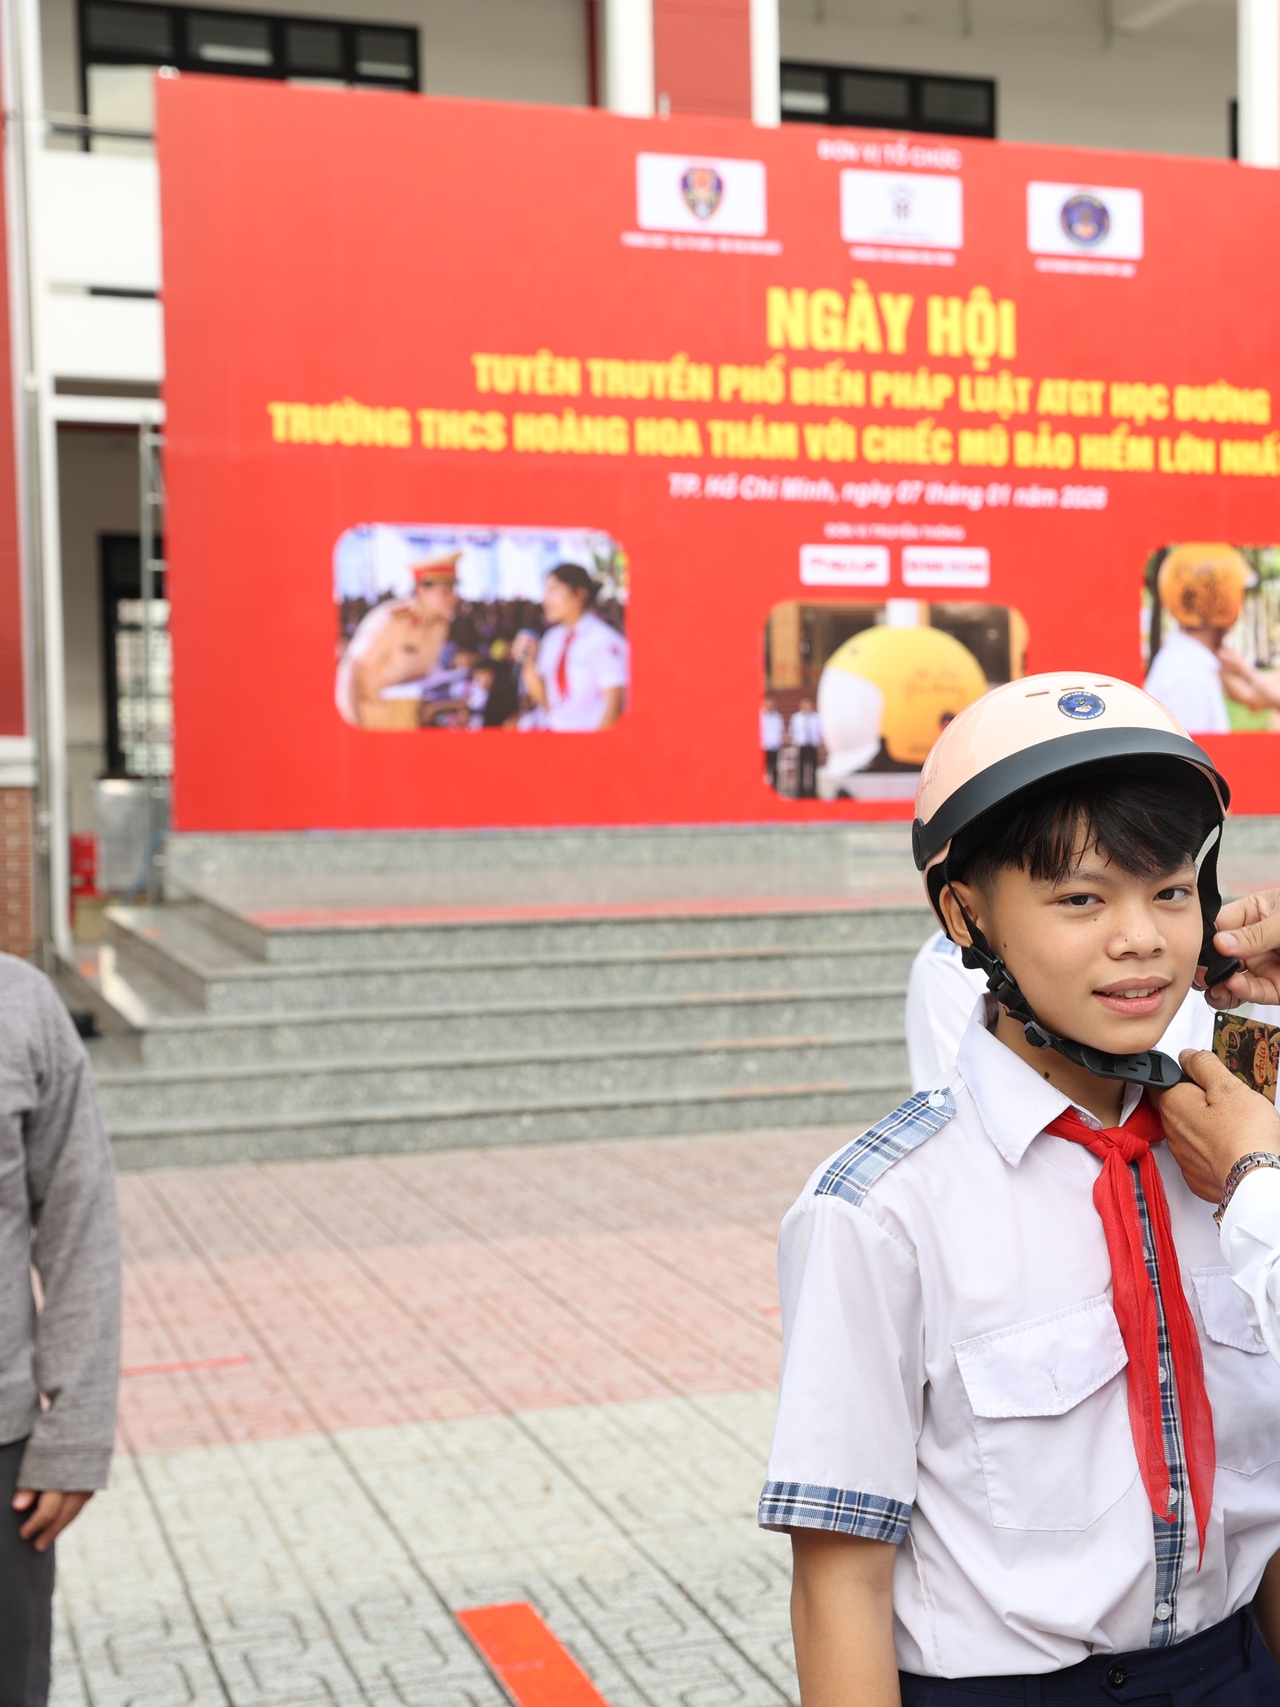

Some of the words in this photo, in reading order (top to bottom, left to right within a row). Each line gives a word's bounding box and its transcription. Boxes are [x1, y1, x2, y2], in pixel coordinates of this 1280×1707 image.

[766, 280, 914, 355] NGÀY
[927, 286, 1017, 371] HỘI
[586, 353, 713, 402] TRUYỀN
[718, 356, 786, 404] PHỔ
[790, 362, 866, 407] BIẾN
[870, 366, 954, 411] PHÁP
[958, 369, 1033, 421] LUẬT
[1036, 378, 1106, 417] ATGT
[1109, 382, 1170, 424] HỌC
[1173, 380, 1271, 425] ĐƯỜNG
[268, 397, 412, 448] TRƯỜNG
[417, 408, 507, 452] THCS
[512, 408, 629, 456] HOÀNG
[634, 416, 702, 458] HOA
[706, 415, 799, 461] THÁM
[803, 417, 857, 463] VỚI
[861, 418, 953, 466] CHIẾC
[958, 423, 1009, 468] MŨ
[1013, 422, 1075, 470] BẢO
[1079, 426, 1154, 473] HIỂM
[1158, 431, 1215, 475] LỚN
[703, 471, 739, 500] Hồ
[739, 474, 779, 501] Chí
[841, 478, 895, 509] ngày
[924, 480, 984, 511] tháng
[1013, 483, 1058, 508] năm
[1255, 1045, 1268, 1079] Asia
